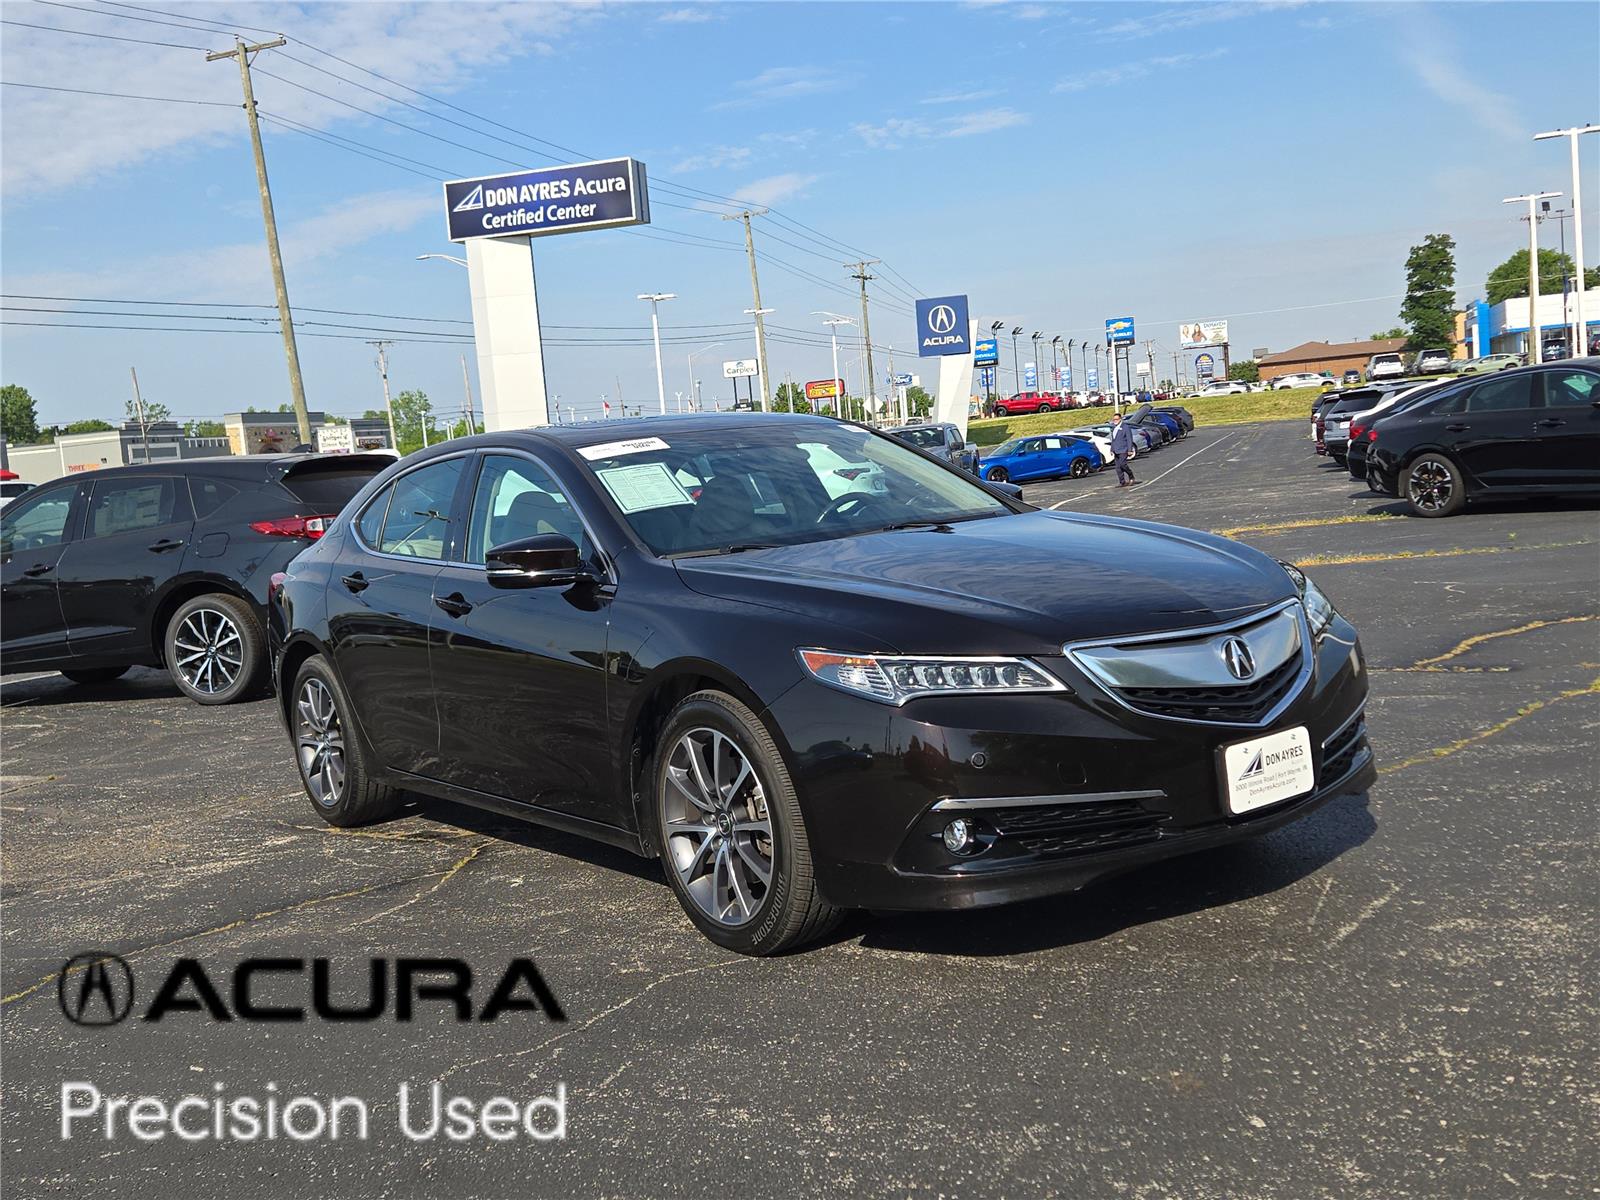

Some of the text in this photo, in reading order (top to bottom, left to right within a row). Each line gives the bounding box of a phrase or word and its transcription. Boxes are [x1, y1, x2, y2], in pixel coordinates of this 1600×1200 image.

[485, 175, 626, 208] DON AYRES Acura
[482, 203, 596, 230] Certified Center
[922, 335, 964, 347] ACURA
[726, 366, 754, 375] Carplex
[1265, 745, 1304, 766] DON AYRES
[751, 871, 787, 946] BRIDGESTONE
